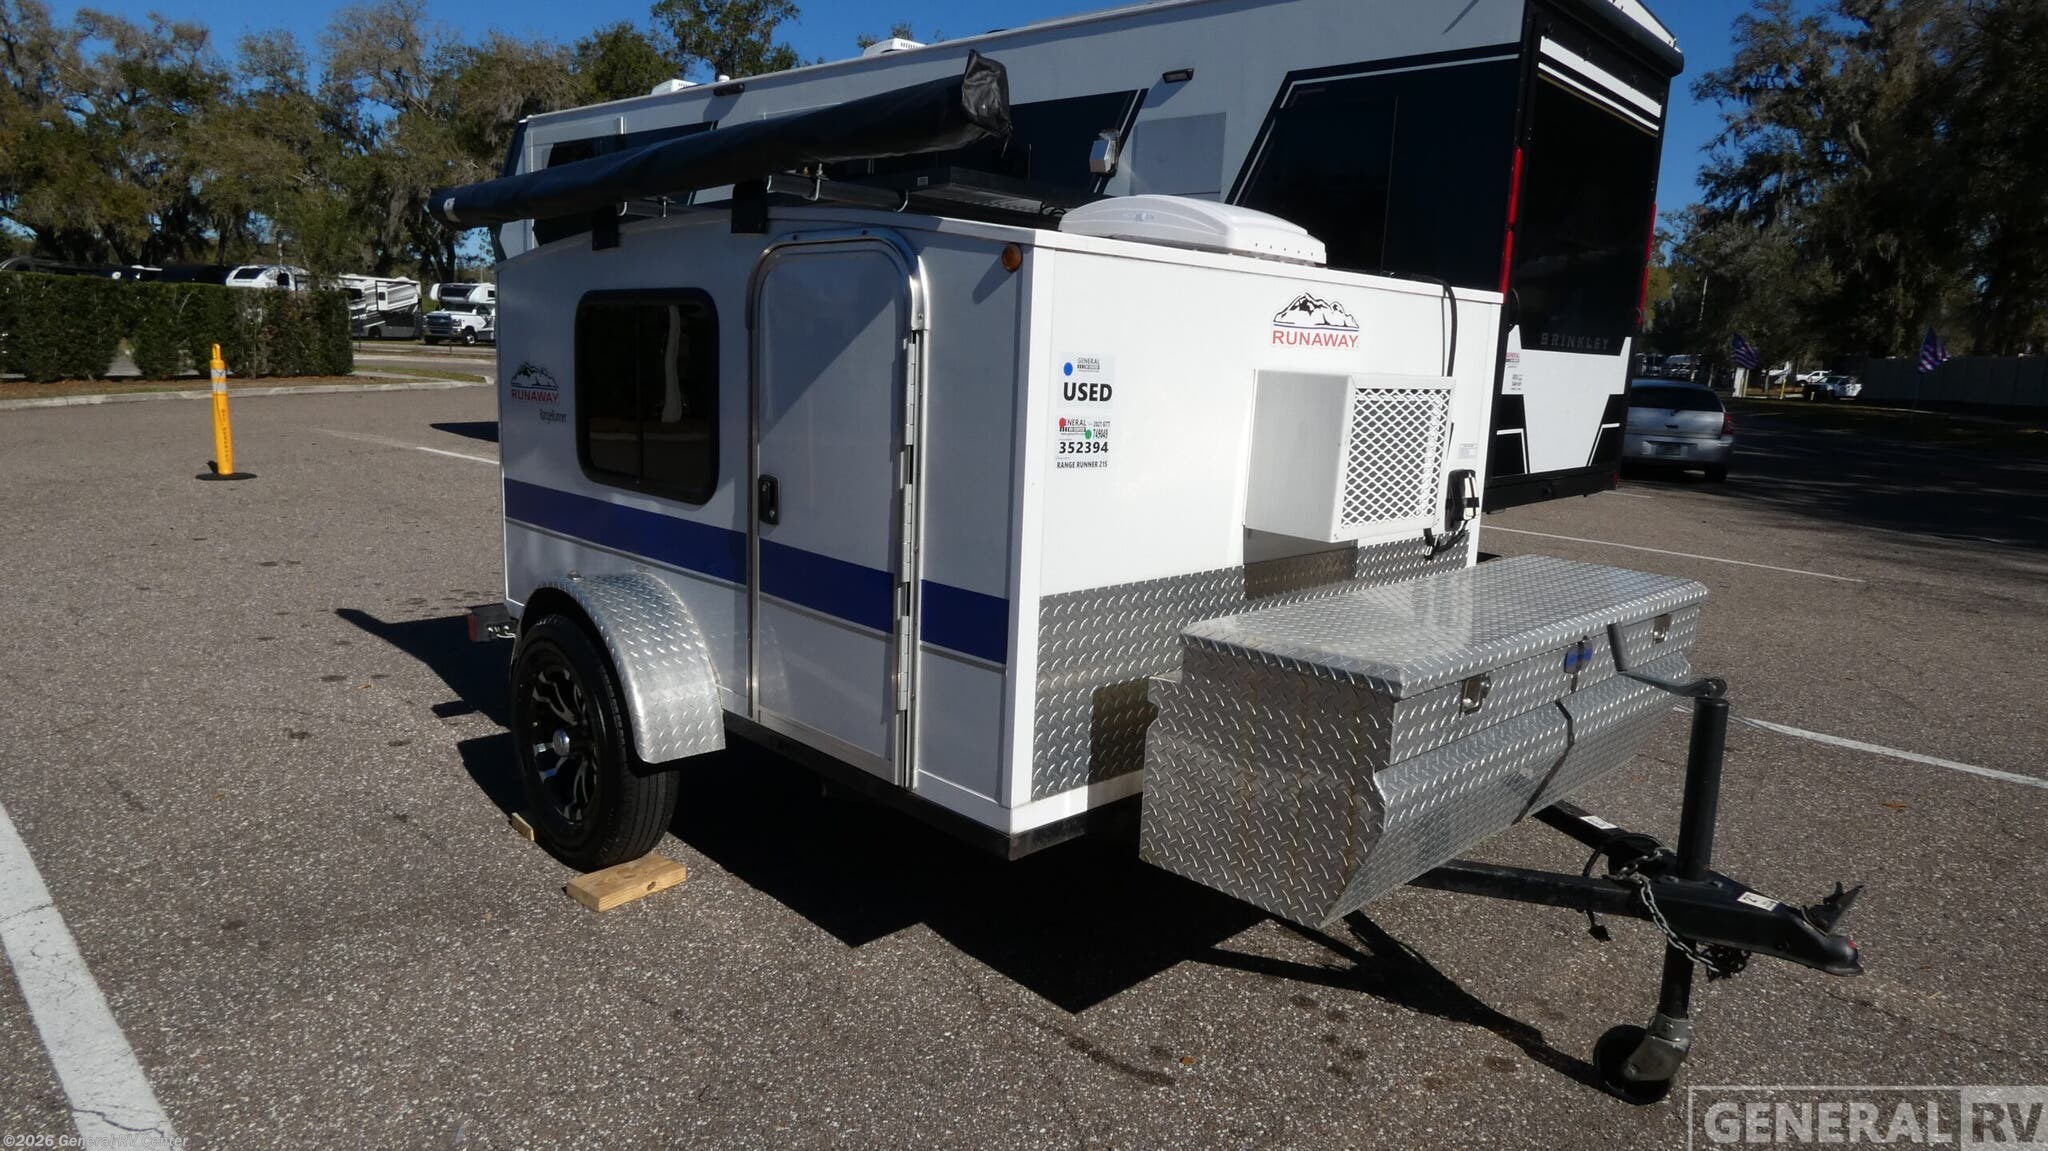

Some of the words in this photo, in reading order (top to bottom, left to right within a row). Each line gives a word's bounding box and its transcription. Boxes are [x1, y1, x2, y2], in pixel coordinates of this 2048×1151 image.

[1272, 330, 1359, 348] RUNAWAY
[1540, 332, 1609, 351] BRINKLEY
[1077, 357, 1100, 365] GENERAL
[511, 389, 559, 404] RUNAWAY
[1063, 382, 1113, 402] USED
[1059, 441, 1109, 454] 352394
[1056, 461, 1075, 469] RANGE
